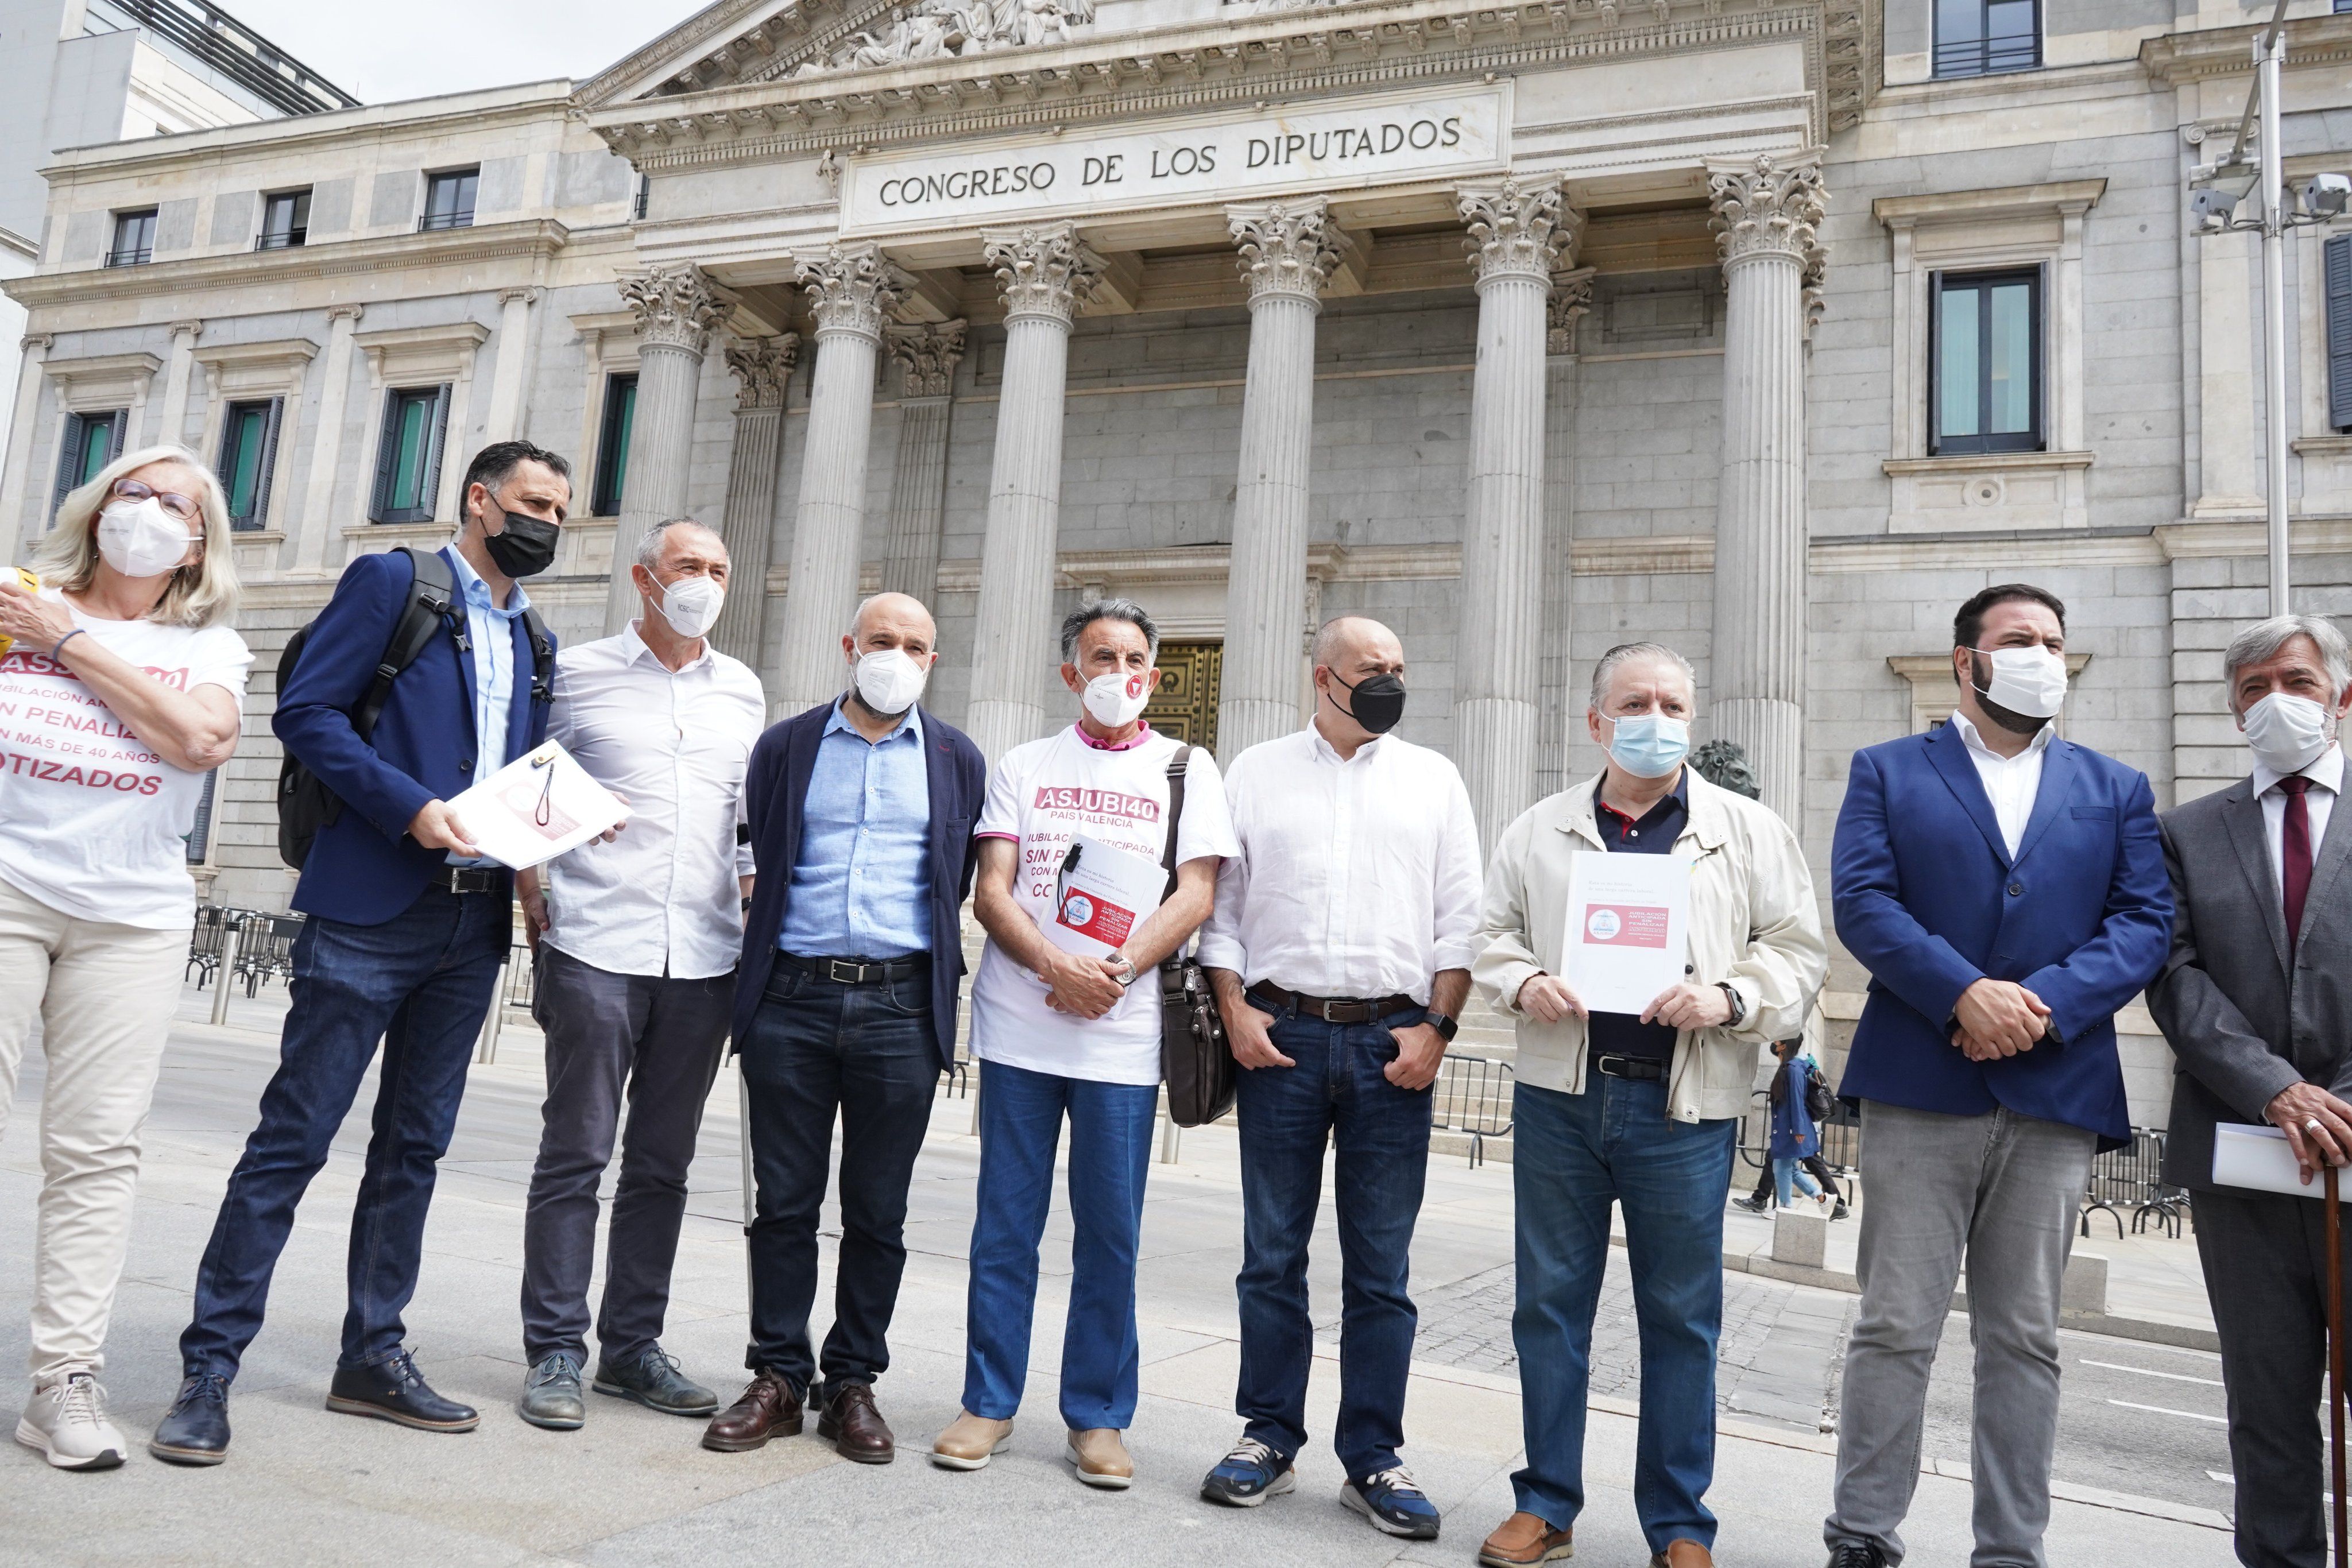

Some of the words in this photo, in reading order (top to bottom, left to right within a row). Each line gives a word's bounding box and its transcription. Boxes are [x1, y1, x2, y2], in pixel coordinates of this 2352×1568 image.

[880, 162, 1055, 206] CONGRESO
[1082, 154, 1124, 186] DE
[1151, 145, 1217, 178] LOS
[1247, 117, 1460, 168] DIPUTADOS
[16, 732, 56, 749] MÁS
[60, 742, 84, 754] DE
[88, 748, 107, 758] 40
[111, 751, 161, 764] AÑOS
[0, 752, 163, 796] TIZADOS
[1040, 789, 1155, 819] ASJUBI40
[1050, 809, 1076, 820] PAÍS
[1079, 812, 1134, 828] VALENCIÀ
[1026, 849, 1050, 864] SIN
[1031, 867, 1051, 876] CON
[1098, 873, 1115, 883] historia
[1101, 909, 1131, 924] ANTICIPADA
[1102, 906, 1132, 921] JUBILACIÓN
[1099, 916, 1128, 930] PENALIZAR
